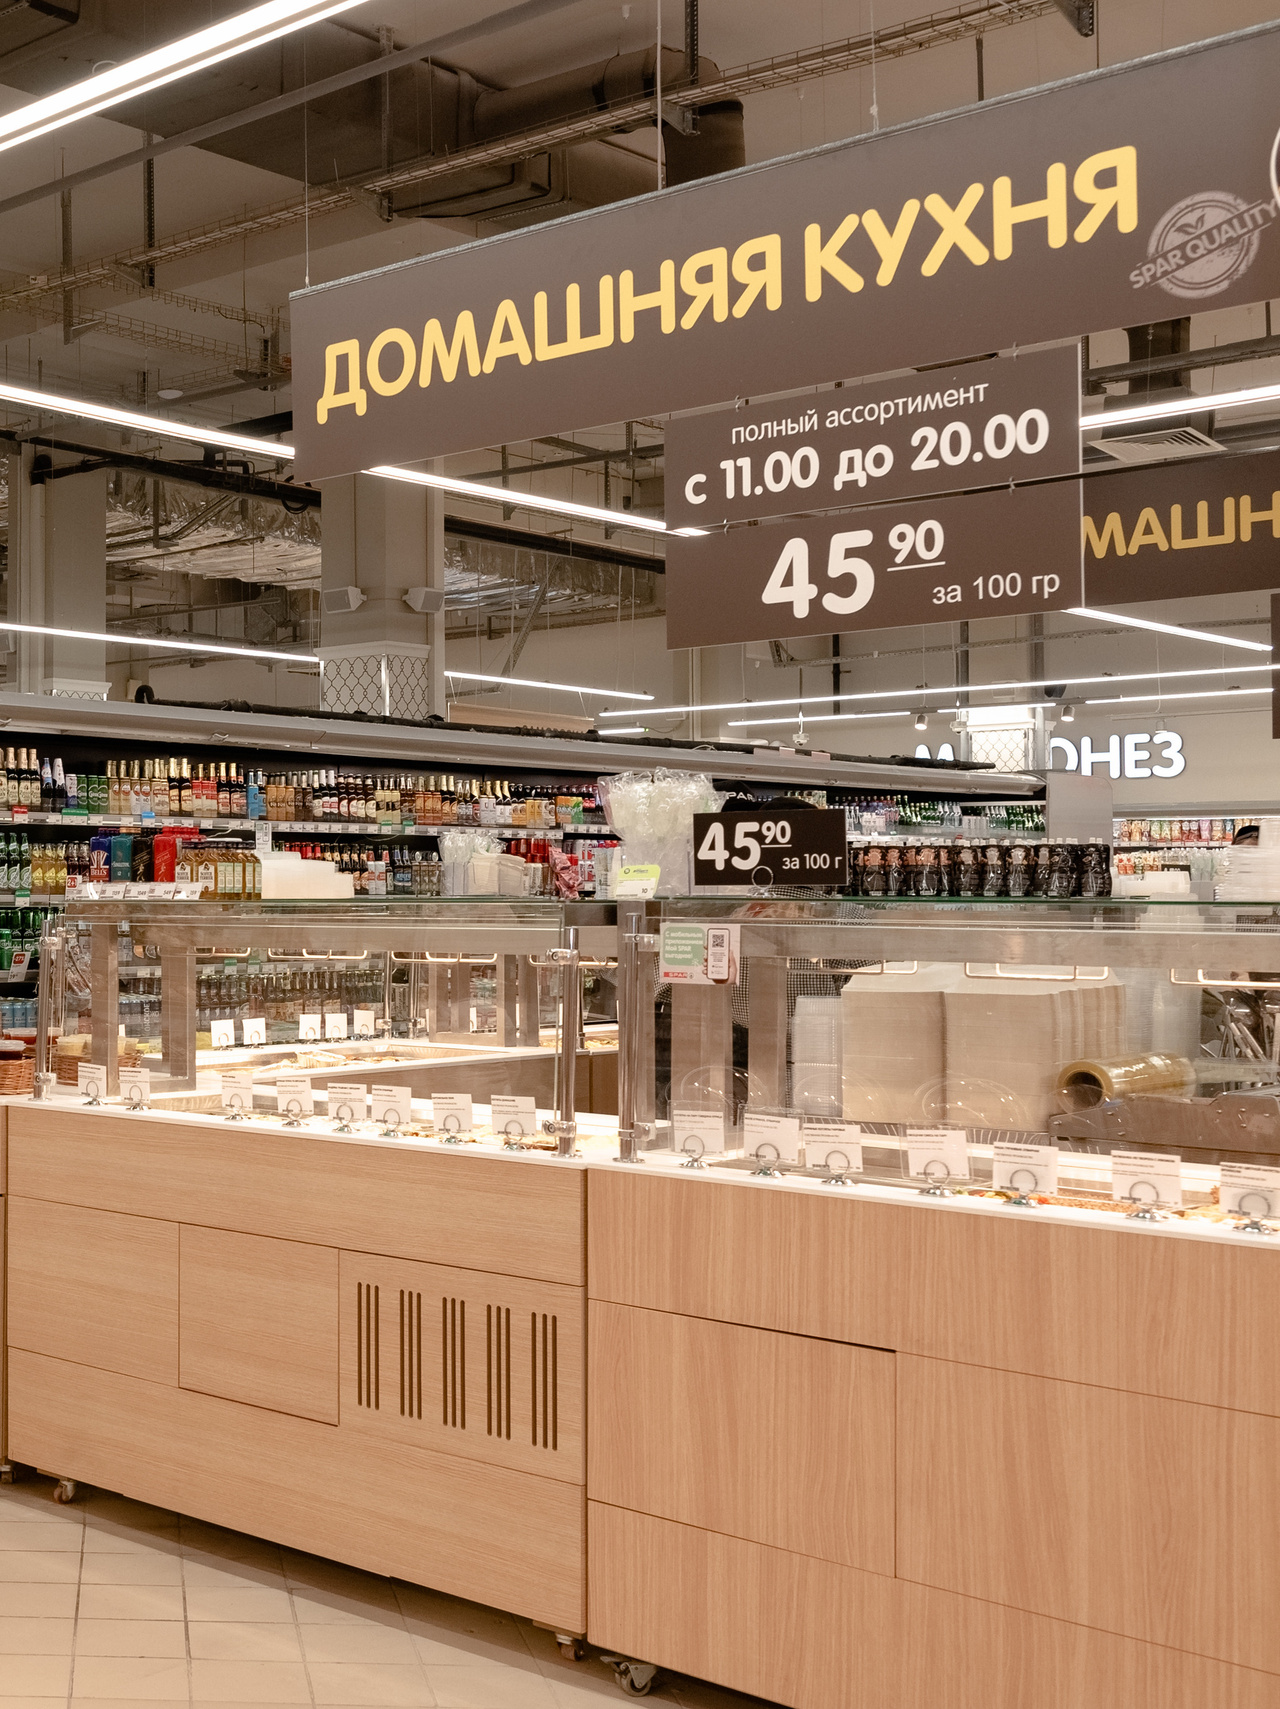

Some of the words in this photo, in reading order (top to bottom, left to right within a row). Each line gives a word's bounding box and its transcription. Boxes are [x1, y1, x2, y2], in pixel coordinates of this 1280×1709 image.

[1129, 250, 1186, 289] SPAR
[1185, 199, 1280, 259] QUALITY
[317, 233, 782, 424] ДОМАШНЯЯ
[804, 145, 1138, 303] КУХНЯ
[732, 409, 819, 445] полный
[826, 382, 989, 429] ассортимент
[685, 473, 706, 505] с
[720, 447, 820, 500] 11.00
[834, 443, 894, 490] до
[911, 408, 1050, 471] 20.00
[762, 530, 875, 619] 45
[888, 519, 945, 565] 90
[932, 582, 962, 605] за
[973, 573, 1022, 600] 100
[1032, 572, 1060, 600] гр
[727, 791, 756, 802] PAR
[697, 822, 762, 871] 45
[762, 821, 791, 844] 90
[782, 857, 799, 869] за
[804, 853, 830, 869] 100
